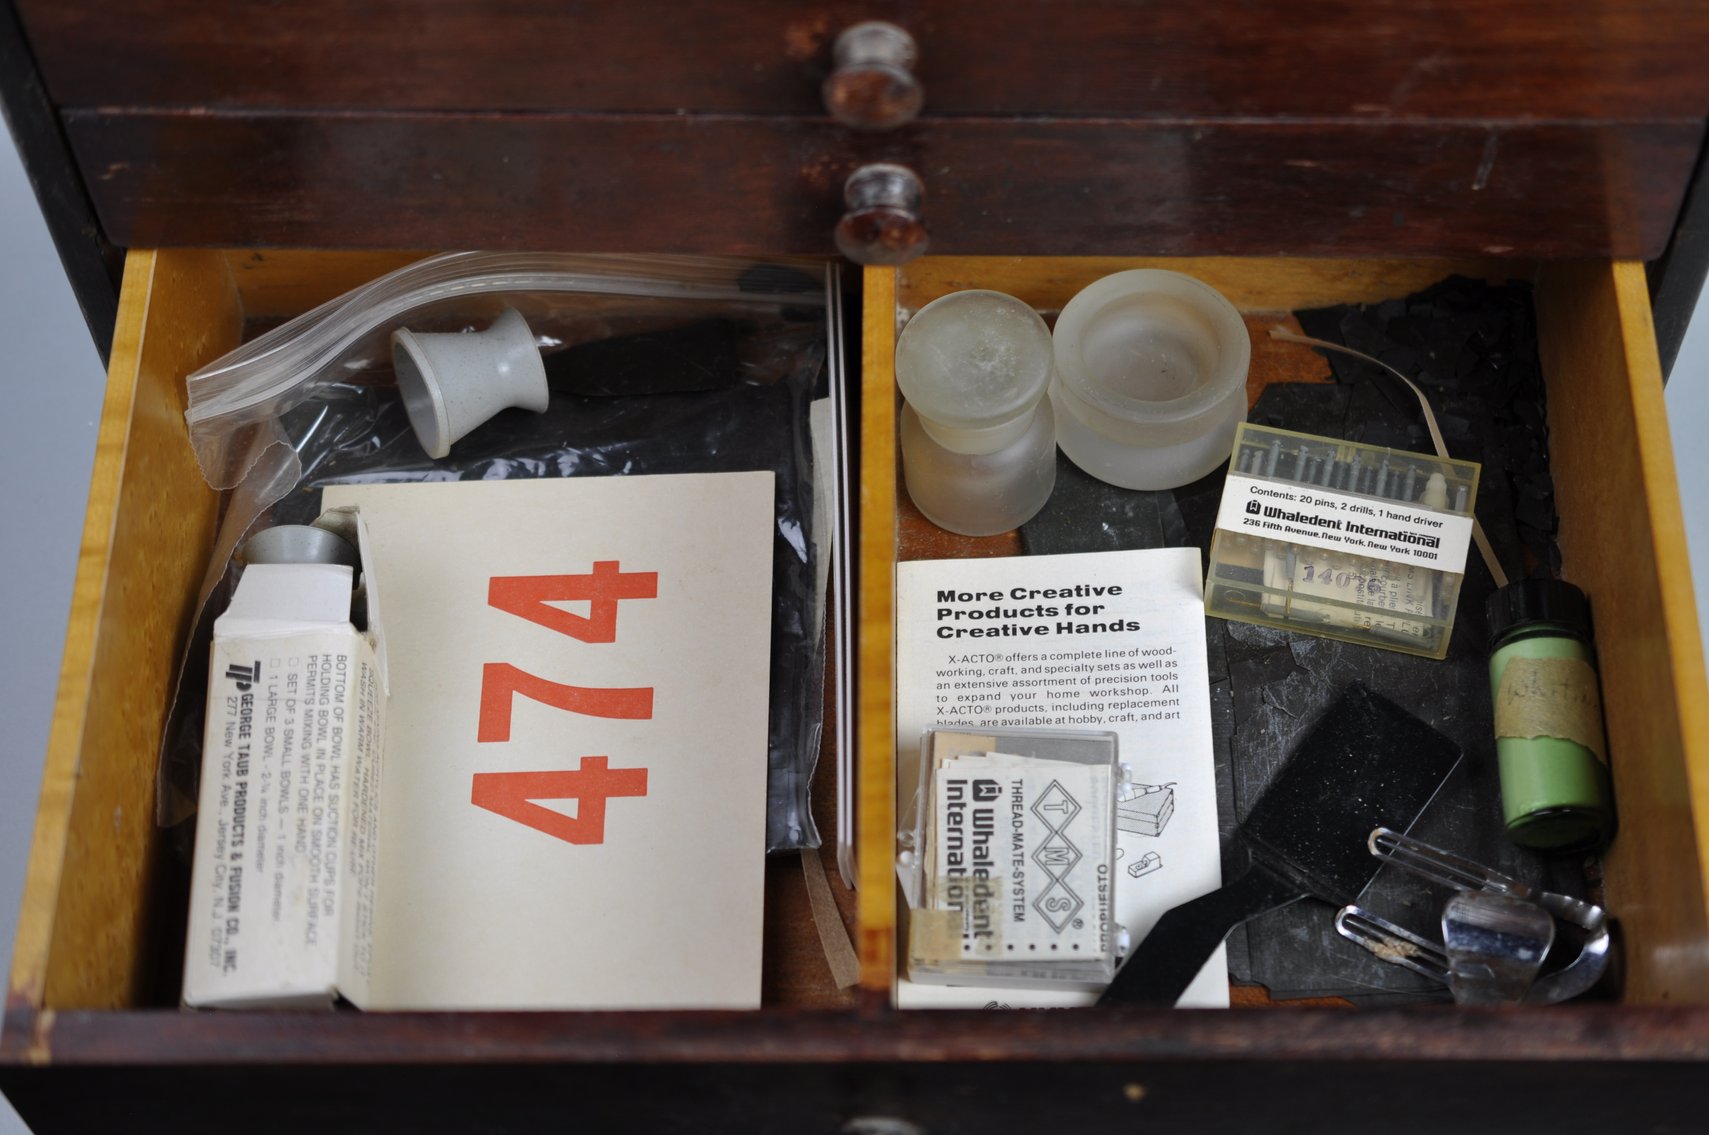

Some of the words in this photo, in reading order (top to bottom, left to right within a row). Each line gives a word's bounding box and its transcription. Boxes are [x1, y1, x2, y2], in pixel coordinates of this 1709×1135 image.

[1250, 486, 1297, 501] Contents:
[1300, 495, 1312, 504] 20
[1314, 499, 1338, 510] pins,
[1341, 502, 1347, 510] 2
[1349, 504, 1376, 517] drills,
[1386, 511, 1411, 522] hand
[1413, 516, 1443, 528] driver
[1243, 518, 1261, 527] 236
[1262, 522, 1282, 531] Fifth
[1322, 532, 1342, 542] New
[1367, 540, 1388, 550] New
[1390, 545, 1411, 556] York
[1414, 550, 1438, 560] 10001
[1263, 505, 1343, 530] Whaledent
[1345, 521, 1441, 548] International
[937, 589, 1004, 603] More
[1010, 584, 1123, 601] Creative
[937, 604, 1060, 621] Products
[1065, 602, 1106, 616] for
[936, 623, 1050, 639] Creative
[1056, 619, 1141, 635] Hands
[936, 667, 986, 678] working,
[988, 666, 1018, 676] craft,
[1020, 665, 1042, 674] and
[1044, 663, 1094, 674] specialty
[1097, 662, 1120, 672] sets
[1123, 662, 1136, 670] as
[1138, 660, 1162, 669] well
[1164, 660, 1178, 668] as
[1006, 652, 1038, 662] offers
[1050, 650, 1102, 661] complete
[1104, 649, 1126, 658] line
[1128, 648, 1139, 657] of
[1142, 646, 1176, 656] wood-
[286, 673, 298, 696] SET
[304, 655, 318, 706] PERMITS
[319, 654, 332, 706] HOLDING
[334, 654, 348, 703] BOTTOM
[360, 662, 368, 696] WASH
[936, 682, 950, 690] an
[954, 679, 1008, 689] extensive
[1012, 677, 1076, 688] assortment
[1080, 676, 1091, 685] of
[1094, 674, 1147, 686] precision
[1150, 672, 1178, 682] tools
[936, 694, 948, 702] to
[957, 692, 1001, 702] expand
[1010, 692, 1037, 702] your
[1046, 690, 1080, 699] home
[1090, 687, 1152, 698] workshop.
[1162, 684, 1179, 694] All
[226, 696, 238, 717] 277
[239, 694, 254, 739] GEORGE
[264, 684, 278, 723] LARGE
[285, 698, 296, 714] OF
[333, 706, 344, 722] OF
[471, 560, 658, 845] 474
[995, 704, 1048, 716] products,
[1052, 700, 1104, 712] including
[1108, 698, 1180, 711] replacement
[1001, 716, 1052, 726] available
[1054, 716, 1065, 725] at
[1068, 715, 1106, 726] hobby,
[1108, 712, 1138, 722] craft,
[1140, 712, 1162, 720] and
[1164, 712, 1180, 720] art
[224, 722, 236, 748] New
[284, 718, 296, 726] 3
[300, 708, 314, 750] MIXING
[316, 710, 330, 744] BOWL
[357, 715, 366, 752] WARM
[236, 744, 250, 778] TAUB
[262, 726, 275, 762] BOWL
[281, 728, 295, 766] SMALL
[315, 748, 327, 760] IN
[331, 726, 344, 763] BOWL
[222, 752, 234, 780] York
[300, 753, 312, 784] WITH
[312, 763, 326, 802] PLACE
[329, 766, 341, 790] HAS
[278, 770, 292, 814] BOWLS
[298, 788, 310, 814] ONE
[232, 782, 248, 848] PRODUCTS
[312, 807, 324, 826] ON
[326, 794, 340, 848] SUCTION
[214, 819, 229, 860] Jersey
[294, 817, 307, 854] HAND
[1011, 778, 1025, 923] THREAD-MATE-SYSTEM
[230, 852, 242, 861] &
[308, 829, 322, 884] SMOOTH
[324, 852, 337, 886] CUPS
[972, 808, 995, 939] Whaledent
[227, 866, 242, 912] FUSION
[322, 890, 336, 916] FOR
[305, 888, 320, 945] SURFACE
